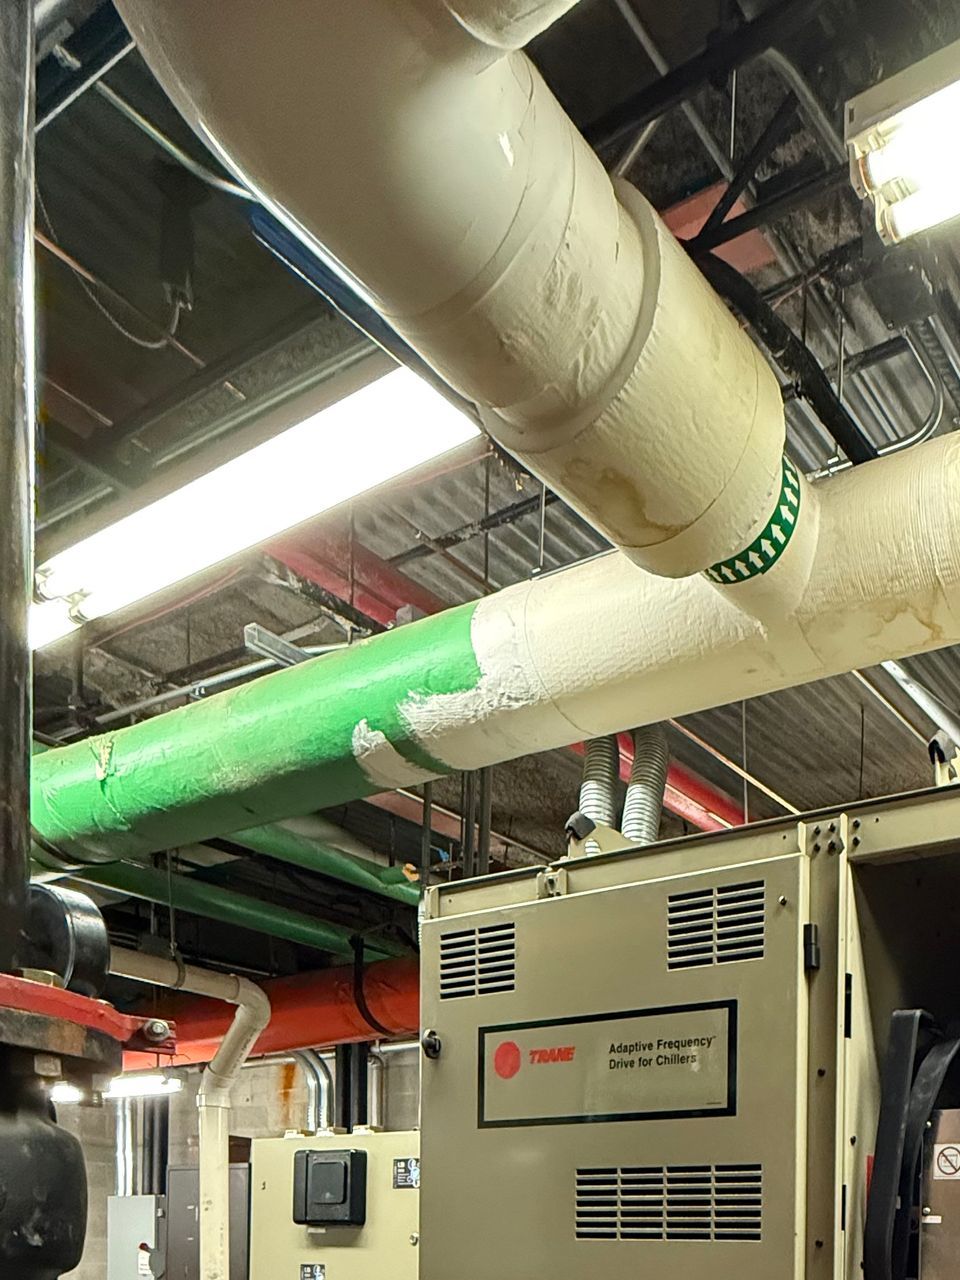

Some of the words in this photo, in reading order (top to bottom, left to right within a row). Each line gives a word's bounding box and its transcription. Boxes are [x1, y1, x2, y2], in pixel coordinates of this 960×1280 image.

[529, 1046, 576, 1064] TRANE
[609, 1038, 653, 1055] Adaptive
[609, 1056, 635, 1070] Drive
[638, 1055, 653, 1068] for
[656, 1053, 697, 1066] Chillers
